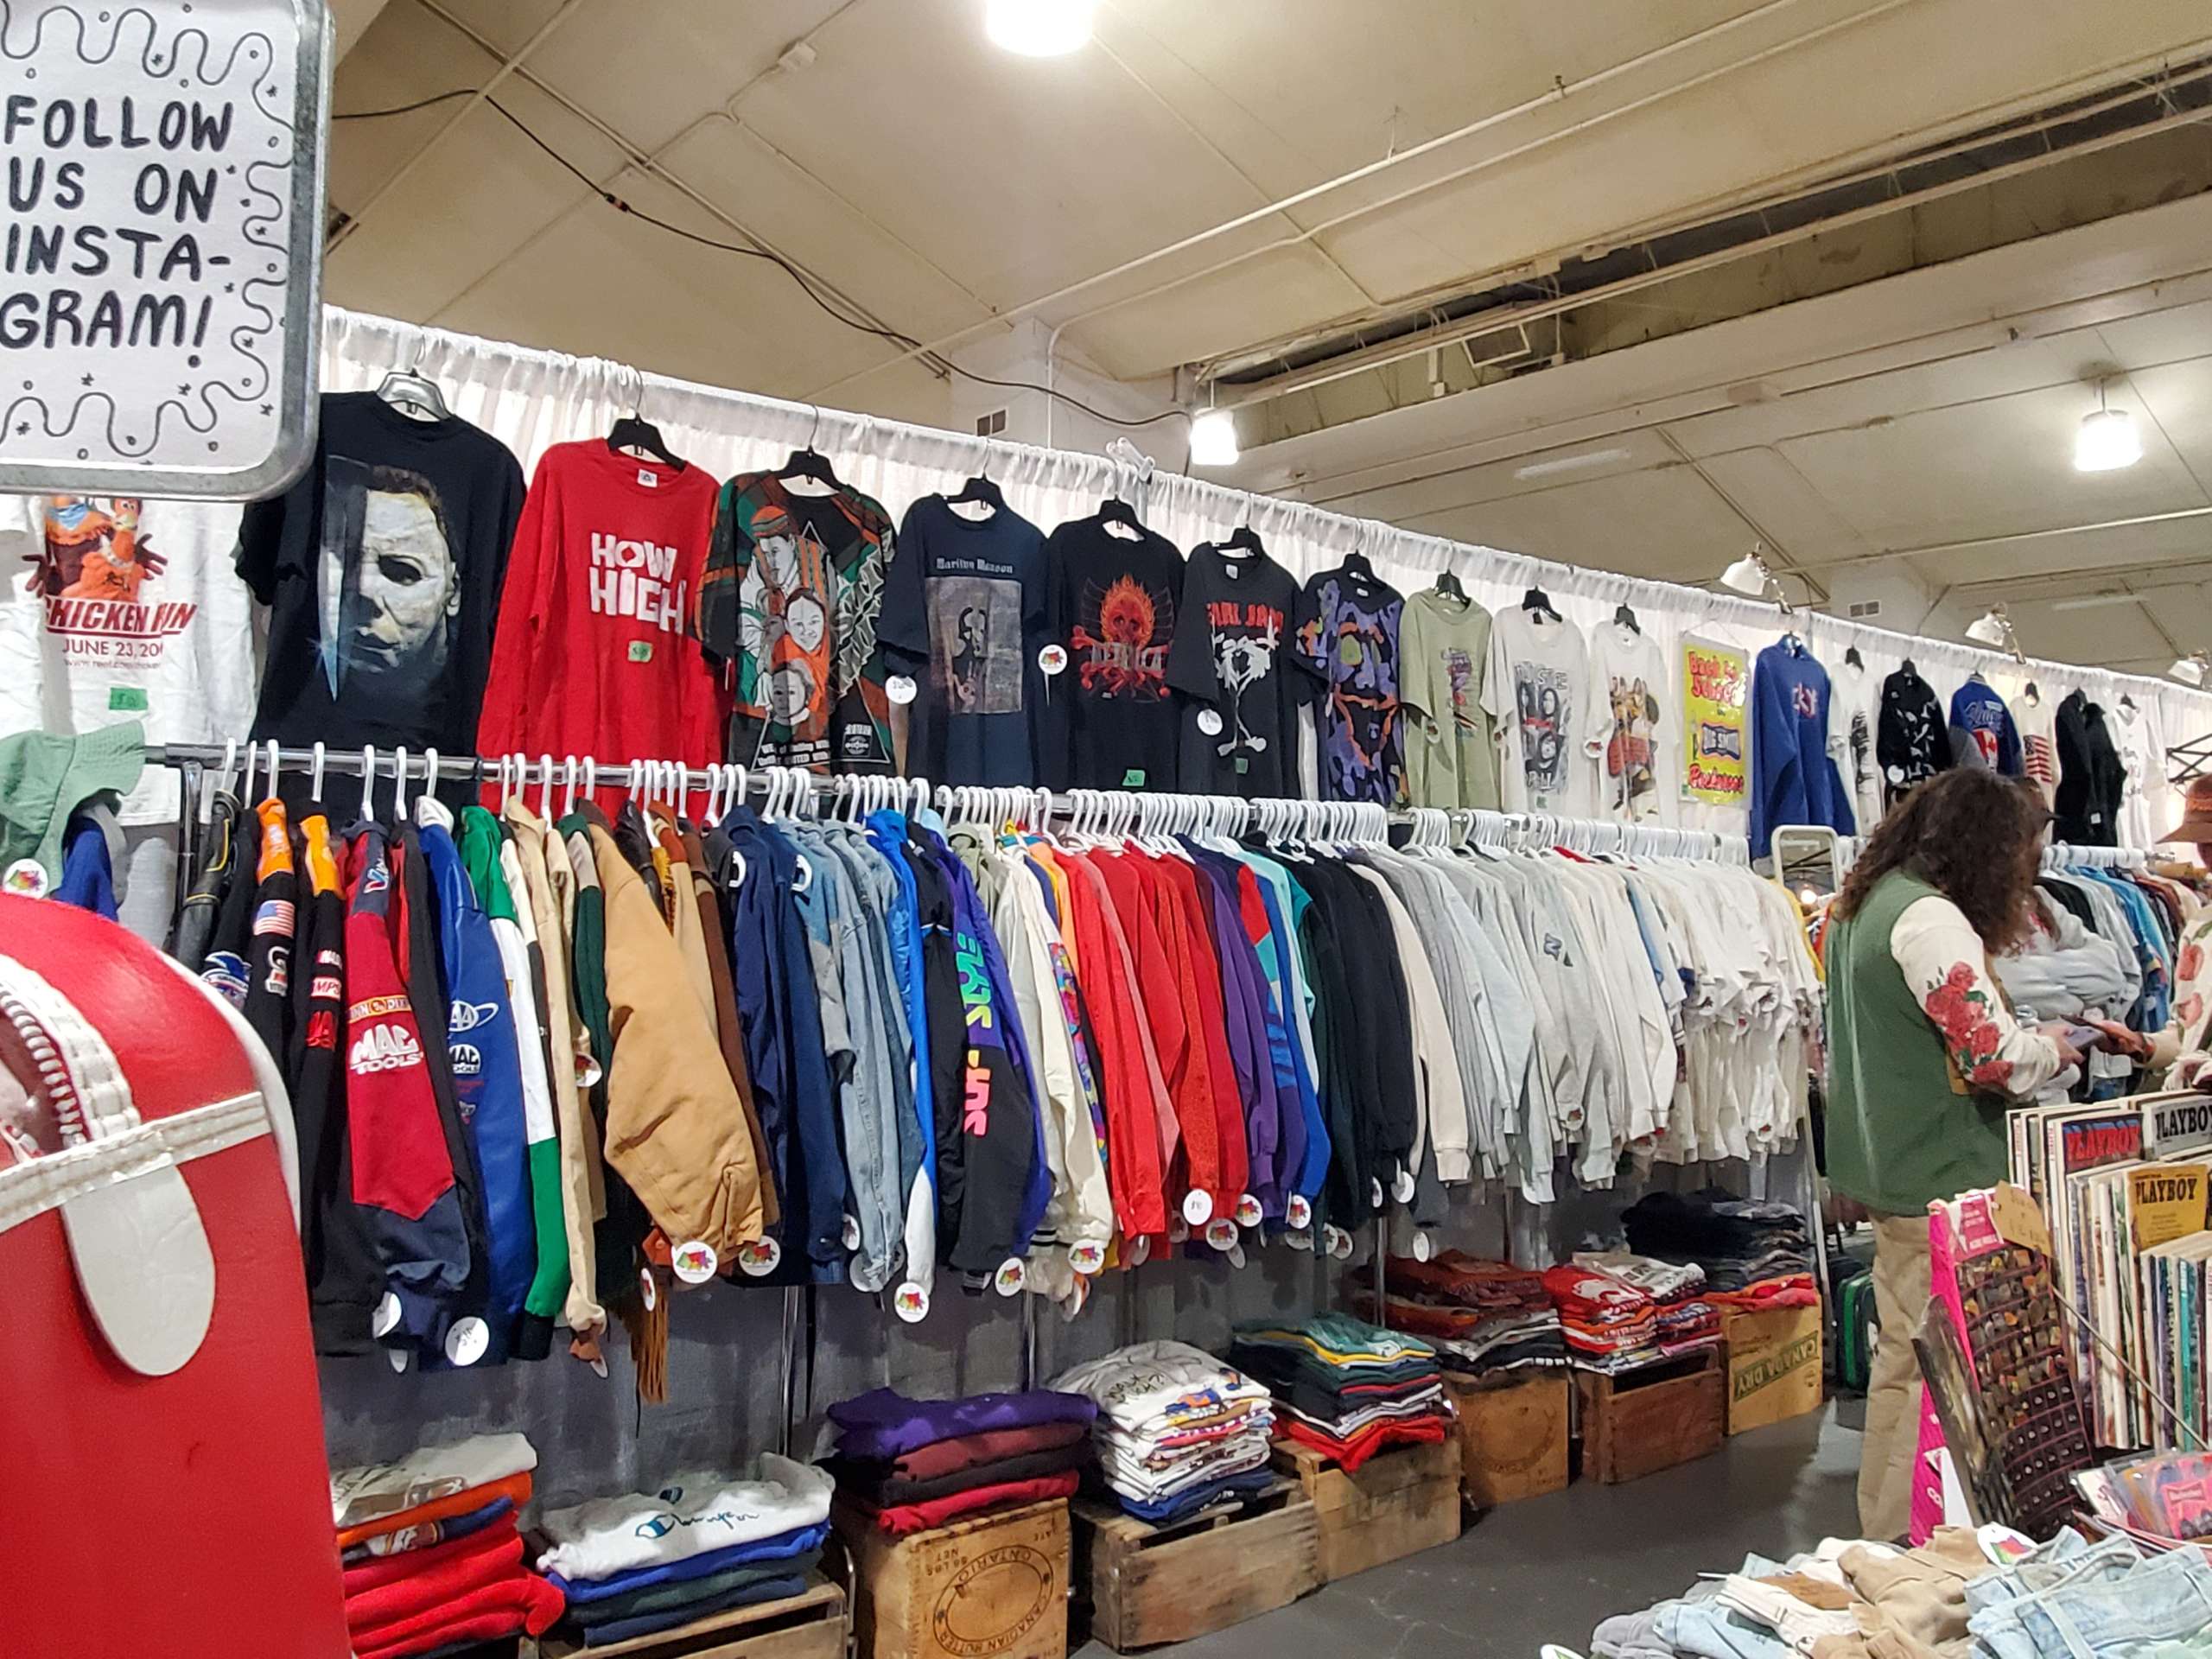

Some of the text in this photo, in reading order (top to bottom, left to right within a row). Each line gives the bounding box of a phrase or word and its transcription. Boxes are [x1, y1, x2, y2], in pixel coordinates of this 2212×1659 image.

[3, 95, 233, 151] FOLLOW
[9, 156, 218, 223] US ON
[5, 222, 231, 282] INSTA-
[0, 289, 213, 369] GRAM!
[591, 532, 677, 583] HOW
[589, 566, 687, 635] HIGH
[62, 639, 110, 656] JUNE
[350, 1023, 419, 1065] MAC
[350, 1052, 423, 1076] TOOLS
[2064, 1123, 2141, 1162] PLAYBOY
[2134, 1178, 2198, 1205] PLAYBOY
[1737, 1365, 1764, 1397] DRY
[957, 1549, 1033, 1583] ONTARIO
